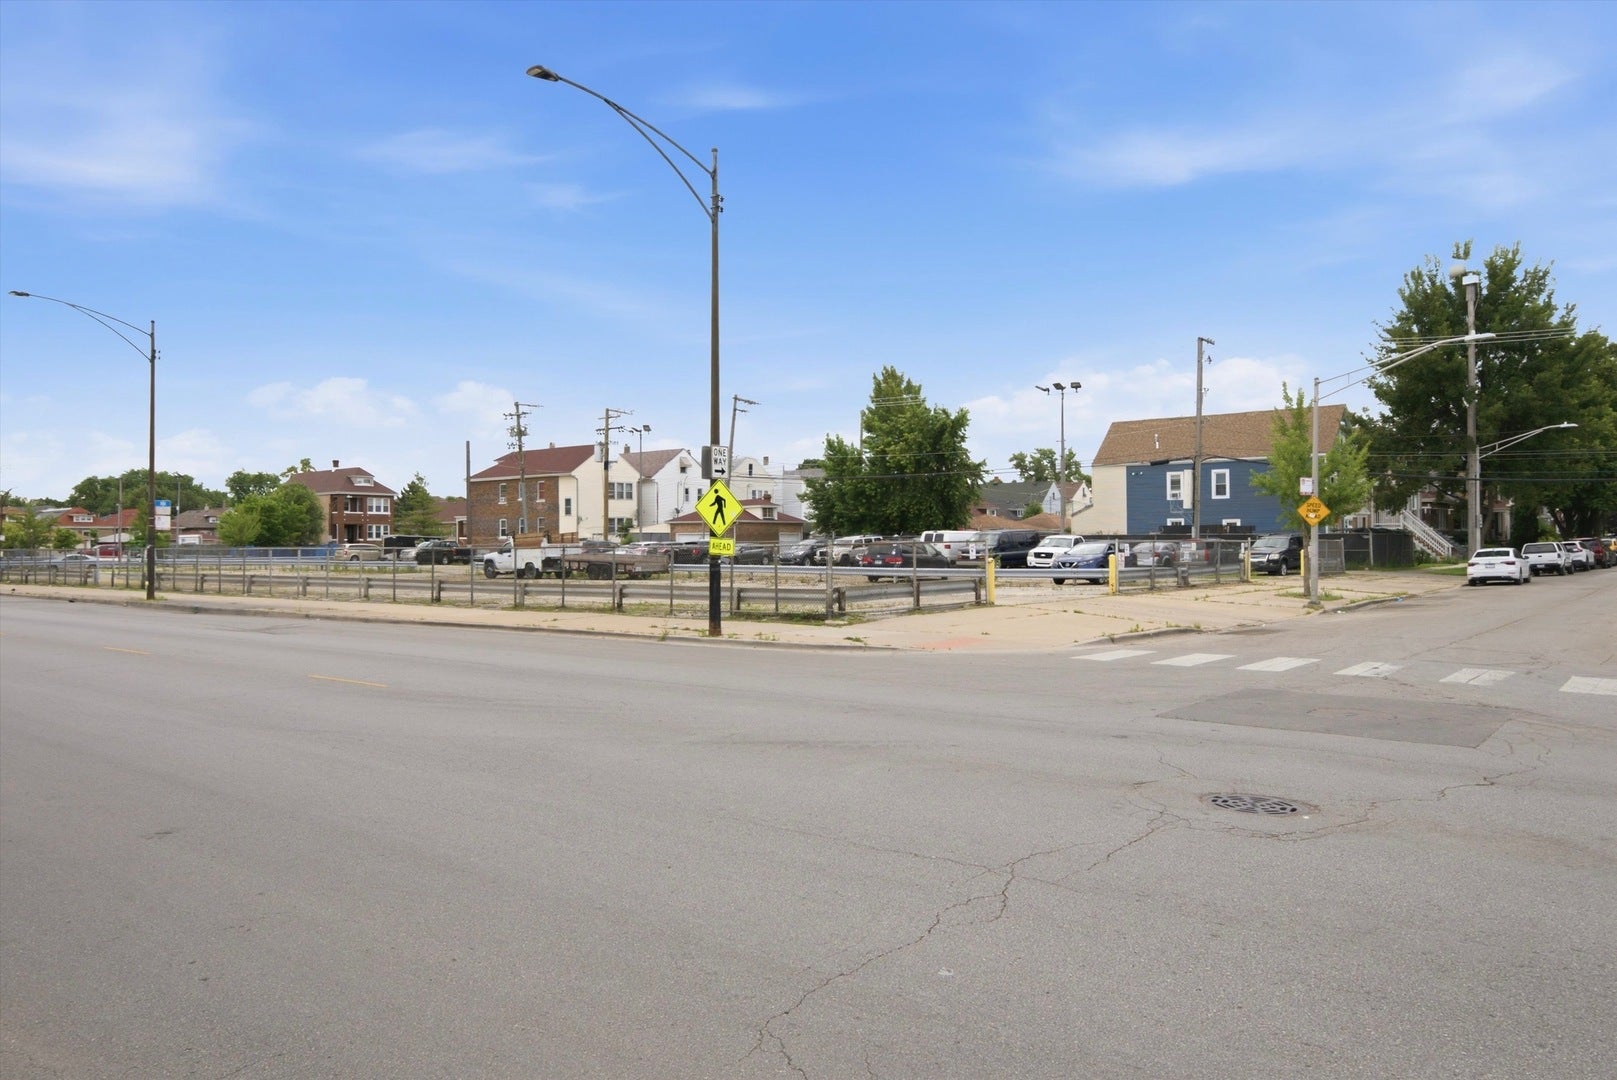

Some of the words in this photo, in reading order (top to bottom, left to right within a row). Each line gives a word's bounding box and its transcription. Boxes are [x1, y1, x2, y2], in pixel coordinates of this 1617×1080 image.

[713, 448, 726, 457] ONE
[713, 457, 726, 465] WAY
[711, 542, 732, 551] AHEAD
